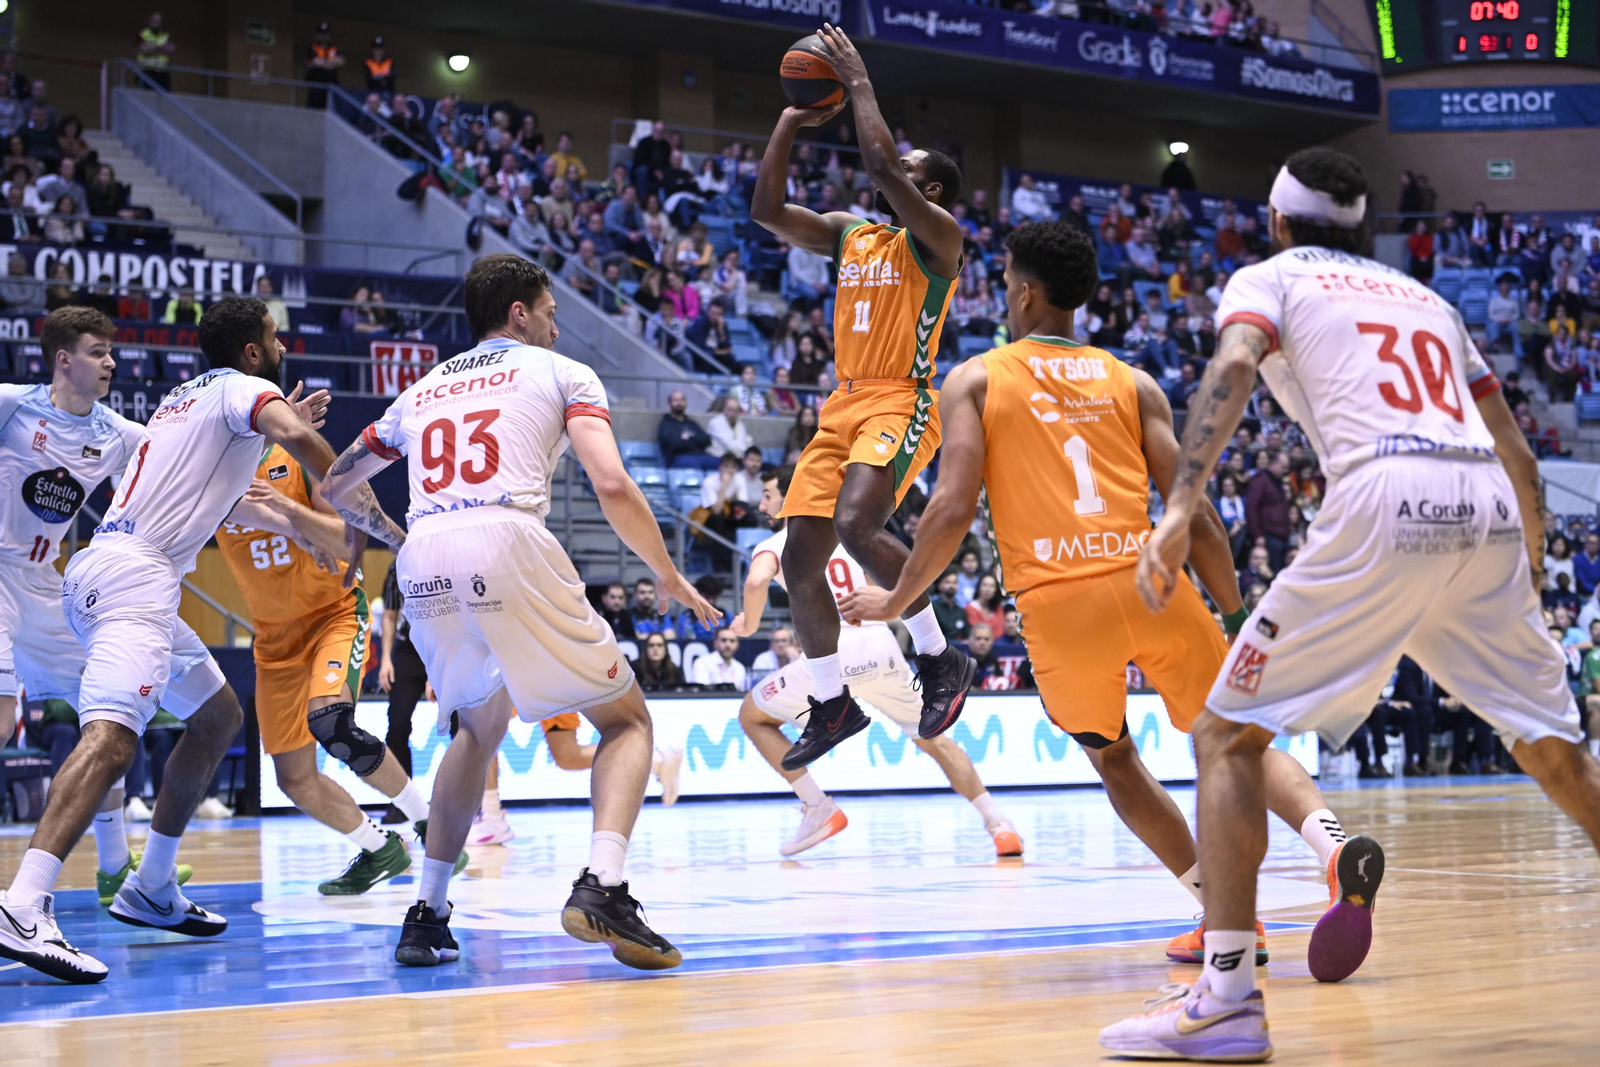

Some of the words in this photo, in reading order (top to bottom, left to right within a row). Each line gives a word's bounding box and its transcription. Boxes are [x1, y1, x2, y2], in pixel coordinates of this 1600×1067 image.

[1463, 90, 1556, 113] cenor
[1345, 275, 1440, 307] cenor
[852, 300, 871, 334] 11
[441, 349, 510, 377] SUAREZ
[1029, 356, 1108, 381] TYSON
[1355, 322, 1464, 424] 30
[433, 367, 521, 399] cenor
[414, 384, 519, 418] electrodomésticos
[1064, 415, 1100, 424] DEPORTE
[421, 408, 501, 495] 93
[35, 476, 78, 501] Estrella
[1063, 434, 1108, 518] 1
[34, 490, 72, 514] Galicia
[1397, 500, 1412, 518] A
[29, 534, 51, 564] 11
[250, 534, 292, 570] 52
[407, 575, 453, 595] Coruña
[414, 605, 462, 620] DESCUBRIR
[415, 595, 461, 611] PROVINCIA
[466, 599, 502, 609] Deputación
[844, 660, 878, 675] Coruña
